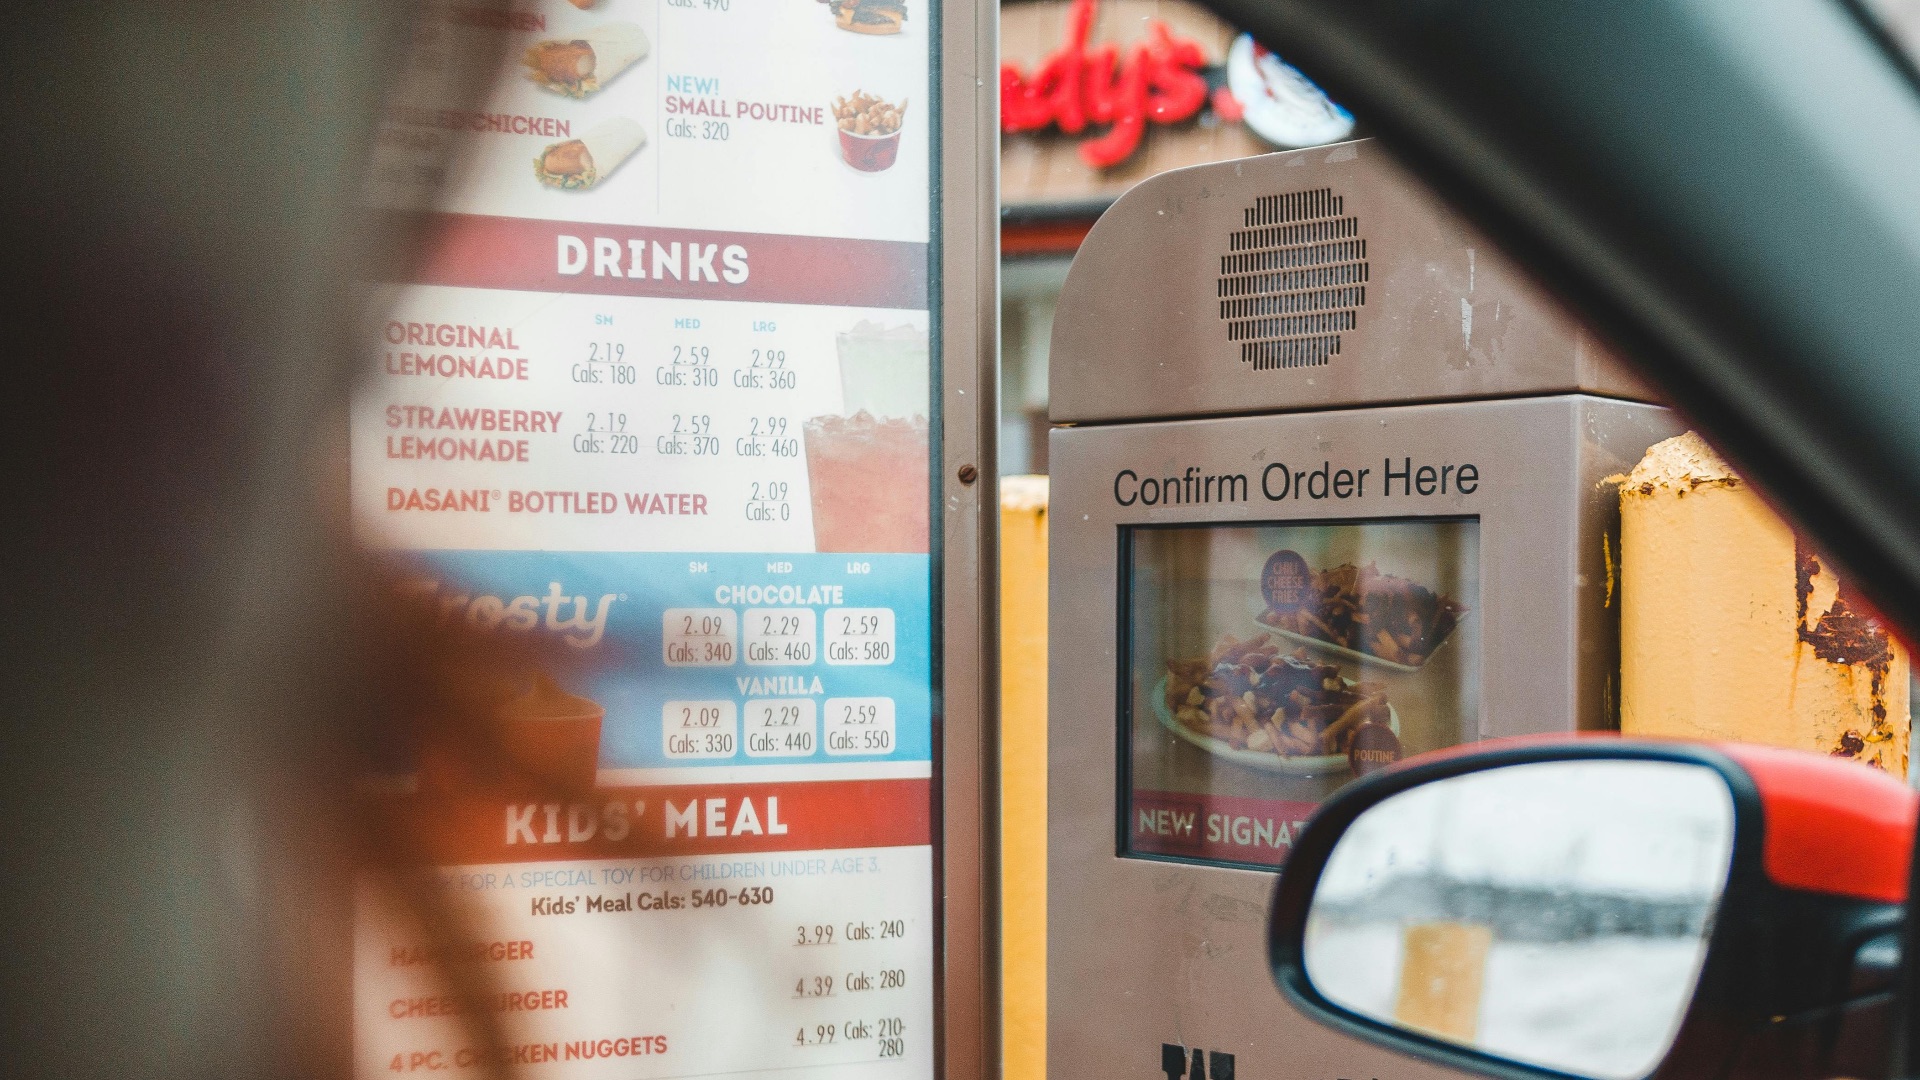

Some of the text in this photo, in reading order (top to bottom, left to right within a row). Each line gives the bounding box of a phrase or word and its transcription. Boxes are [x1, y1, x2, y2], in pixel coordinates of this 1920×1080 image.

[667, 74, 720, 96] NEW!
[665, 96, 824, 125] SMALL POUTINE
[471, 113, 570, 138] CHICKEN
[667, 118, 729, 141] Cals: 320
[557, 234, 750, 285] DRINKS
[385, 321, 520, 350] ORIGINAL
[595, 314, 776, 332] SM MED LRG
[385, 353, 529, 380] LEMONADE
[588, 342, 786, 368] 2.19 2.59 2.99
[572, 364, 796, 390] Cals: 180 Cals: 310 Cals: 360
[386, 404, 562, 432] STRAWBERRY
[587, 412, 787, 436] 2.19 2.59 2.99
[386, 436, 529, 462] LEMONADE
[574, 434, 798, 458] Cals: 220 Cals: 370 Cals: 460
[751, 482, 788, 500] 2.09
[1114, 458, 1479, 506] Confirm Order Here
[508, 490, 618, 514] BOTTLED
[624, 492, 708, 515] WATER
[746, 502, 790, 521] Cals: 0
[689, 561, 871, 574] SM MED LRG
[715, 584, 844, 605] CHOCOLATE
[1268, 576, 1304, 589] CHEESE
[1272, 590, 1299, 604] FRIES
[684, 615, 878, 636] 2.09 2.29 2.59
[668, 642, 890, 662] Cals: 340 Cals: 460 Cals: 580
[736, 675, 824, 696] VANILLA
[682, 705, 877, 727] 2.09 2.29 2.59
[669, 730, 890, 754] Cals: 330 Cals: 440 Cals: 550
[1354, 750, 1395, 762] POUTINE
[506, 796, 788, 845] KIDS' MEAL
[1138, 808, 1195, 836] NEW
[460, 872, 497, 891] FOR
[502, 873, 516, 888] A
[521, 868, 597, 888] SPECIAL
[602, 866, 635, 885] TOY
[640, 865, 674, 882] FOR
[680, 861, 765, 880] CHILDREN
[770, 858, 826, 877] UNDER
[831, 856, 864, 874] AGE
[531, 886, 774, 916] Kids' Meal Cals: 540-630
[796, 920, 904, 945] 3.99 Cals: 240
[796, 969, 905, 998] 4.39 Cals: 280
[796, 1017, 906, 1046] 4.99 Cals: 210-
[389, 1053, 403, 1072] 4
[410, 1050, 448, 1072] PC.
[564, 1035, 668, 1061] NUGGETS
[878, 1038, 904, 1058] 280
